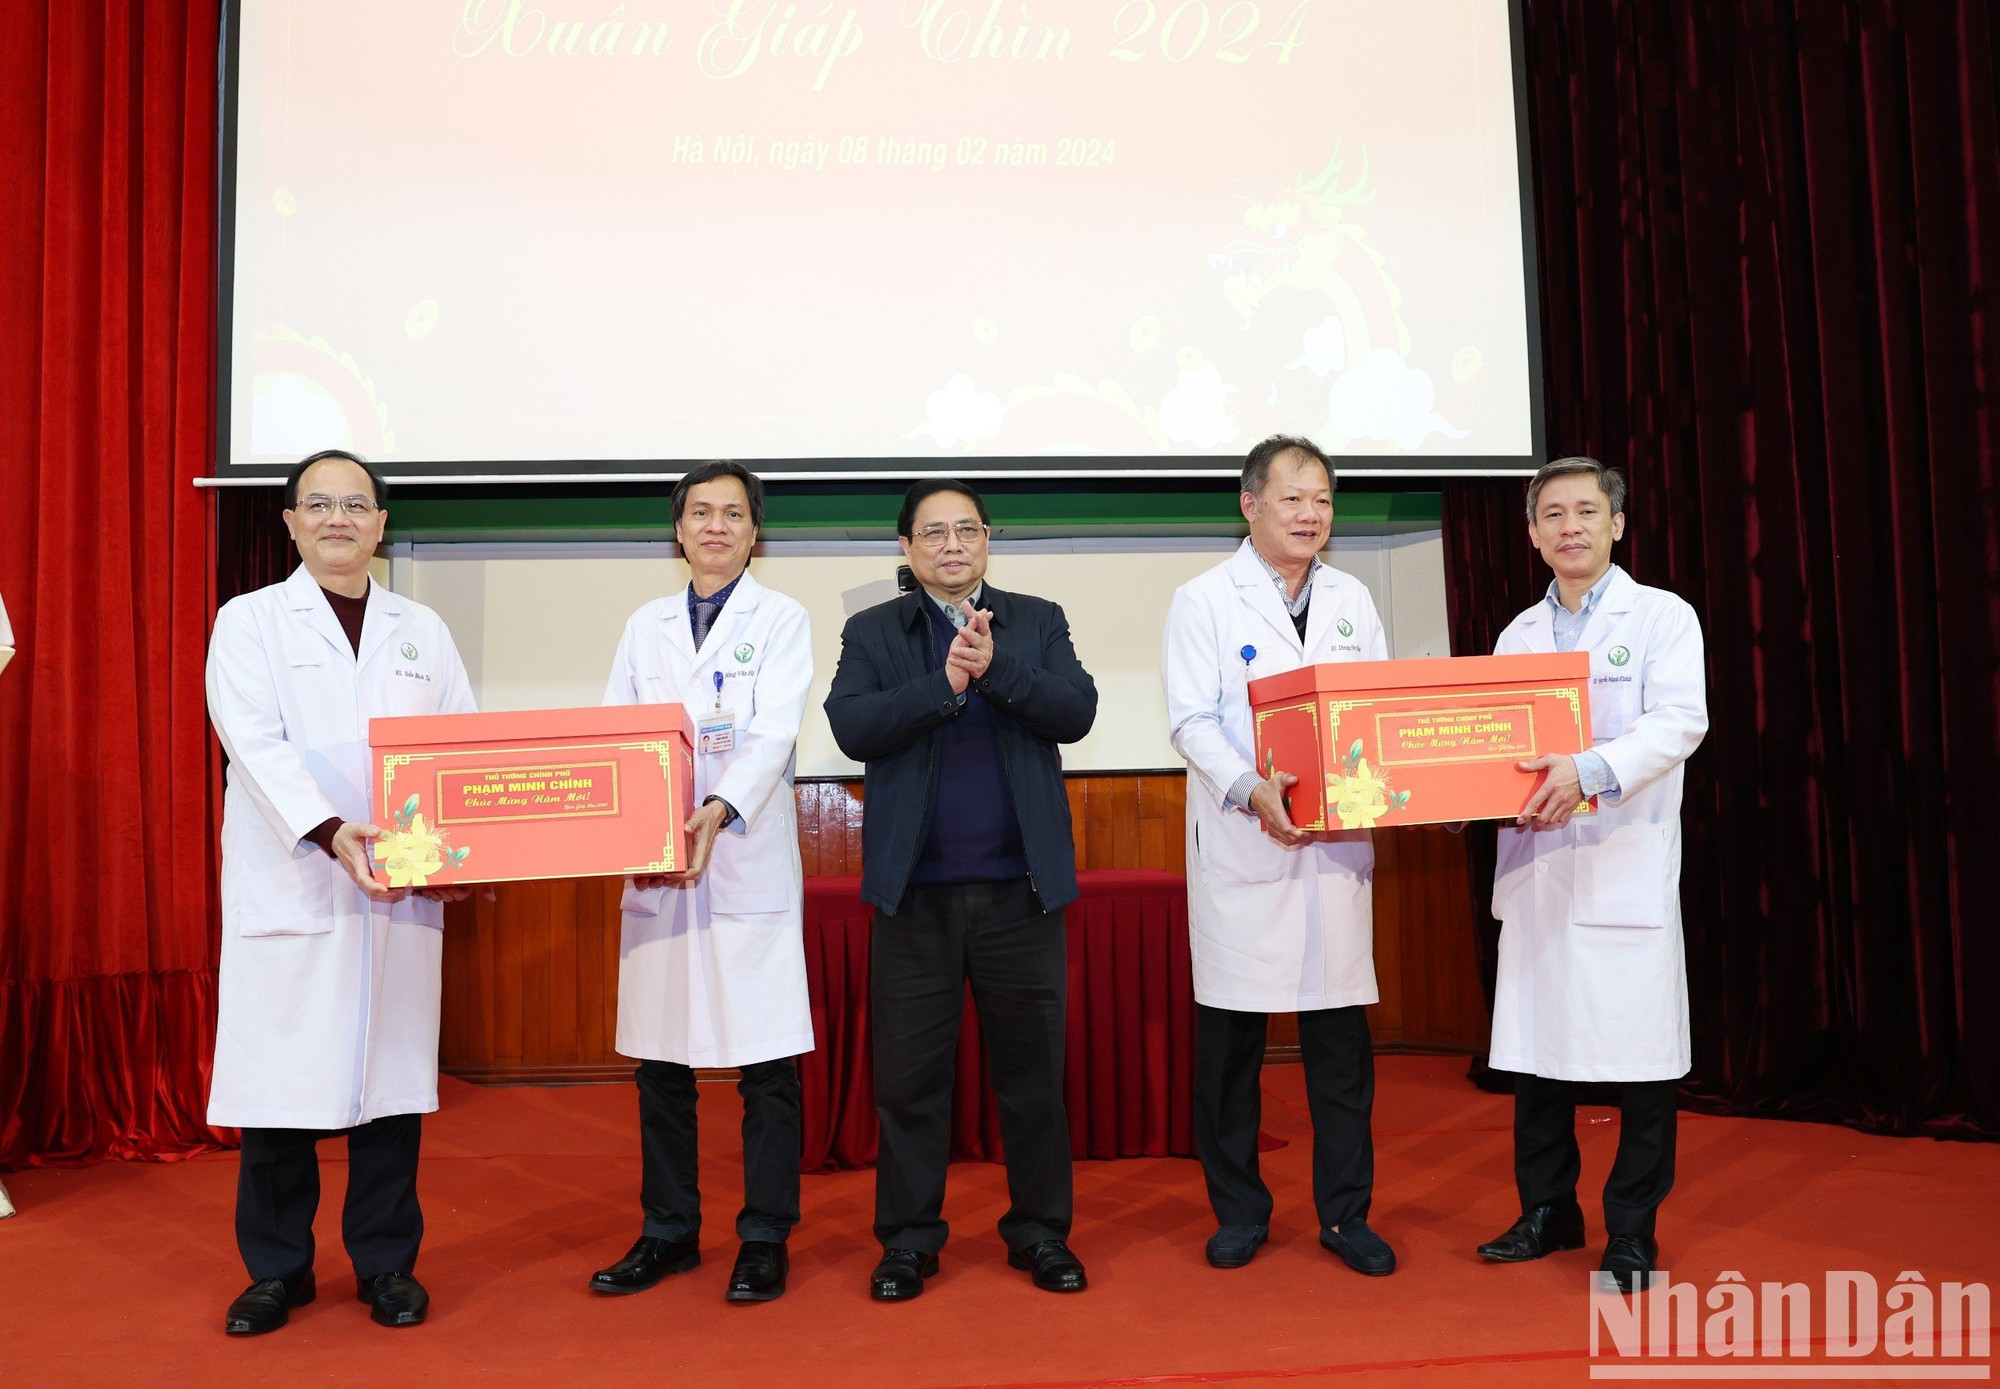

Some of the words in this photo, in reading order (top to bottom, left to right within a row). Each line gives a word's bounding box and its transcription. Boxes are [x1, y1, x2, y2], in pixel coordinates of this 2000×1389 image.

[451, 0, 674, 58] Xuân
[697, 0, 865, 91] Giáp
[1107, 0, 1311, 65] 2024
[672, 134, 704, 165] Hà
[712, 134, 760, 172] Nội,
[768, 135, 830, 171] ngày
[838, 135, 869, 165] 08
[876, 135, 948, 171] tháng
[956, 136, 987, 166] 02
[994, 136, 1048, 166] năm
[1056, 138, 1117, 167] 2024
[1399, 727, 1435, 739] PHẠM
[1439, 724, 1471, 736] MINH
[1475, 722, 1512, 733] CHÍNH
[484, 773, 500, 781] THỦ
[529, 770, 553, 779] CHÍNH
[555, 769, 571, 778] PHỦ
[463, 784, 505, 796] PHẠM
[508, 781, 546, 792] MINH
[550, 778, 593, 790] CHÍNH
